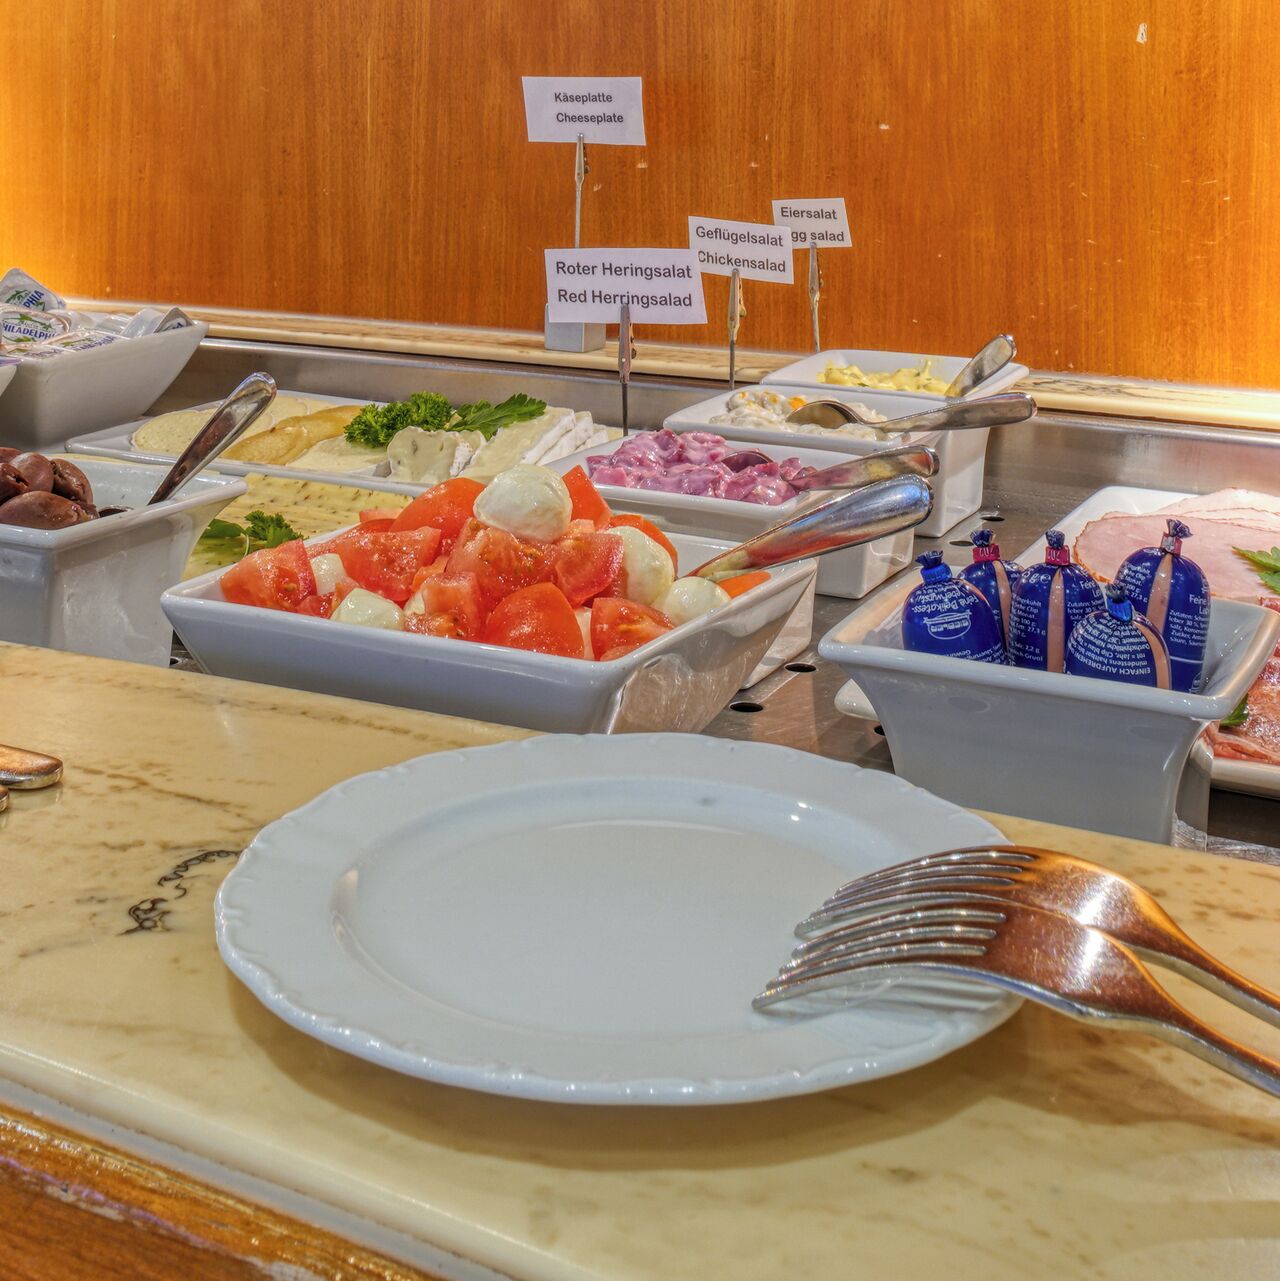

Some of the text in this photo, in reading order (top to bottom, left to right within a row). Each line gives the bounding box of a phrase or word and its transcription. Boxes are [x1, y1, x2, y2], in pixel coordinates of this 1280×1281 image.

[554, 91, 613, 105] Käseplatte
[556, 111, 624, 125] Cheeseplate
[780, 207, 838, 220] Eiersalat
[695, 226, 784, 248] Geflügelsalat
[791, 230, 845, 243] gg salad
[697, 251, 786, 273] Chickensalad
[555, 261, 693, 280] Roter Heringsalat
[557, 289, 692, 308] Red Herringsalad
[1120, 667, 1150, 675] EINFACH
